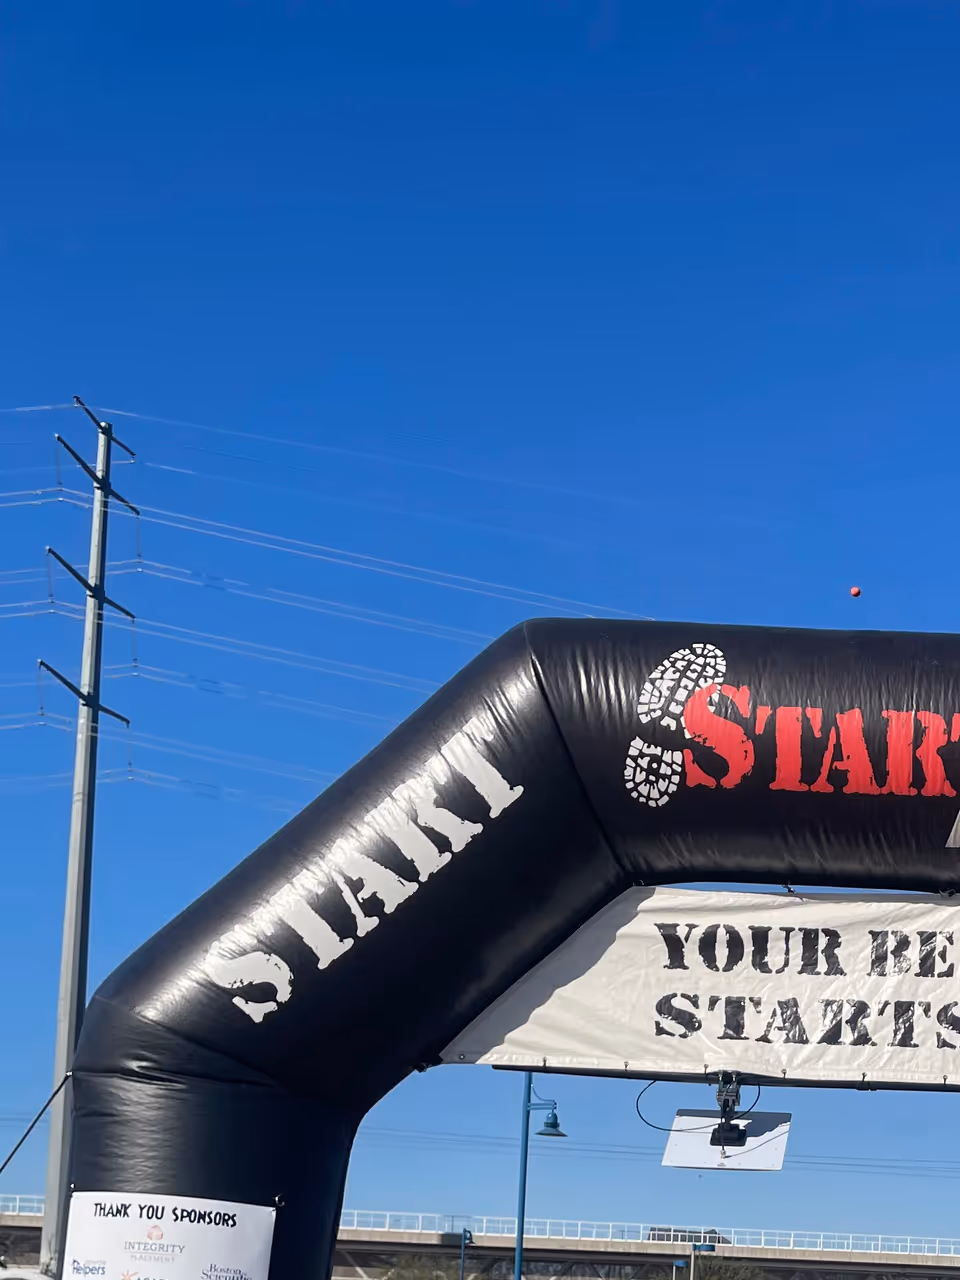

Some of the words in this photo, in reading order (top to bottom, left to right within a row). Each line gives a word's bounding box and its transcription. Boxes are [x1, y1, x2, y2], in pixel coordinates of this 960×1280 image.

[203, 717, 525, 1024] START
[653, 922, 844, 976] YOUR
[93, 1202, 132, 1218] THANK
[138, 1205, 165, 1220] YOU
[172, 1206, 237, 1228] SPONSORS
[124, 1241, 186, 1253] INTEGRITY
[72, 1262, 106, 1277] Helpers
[209, 1264, 242, 1274] Boston
